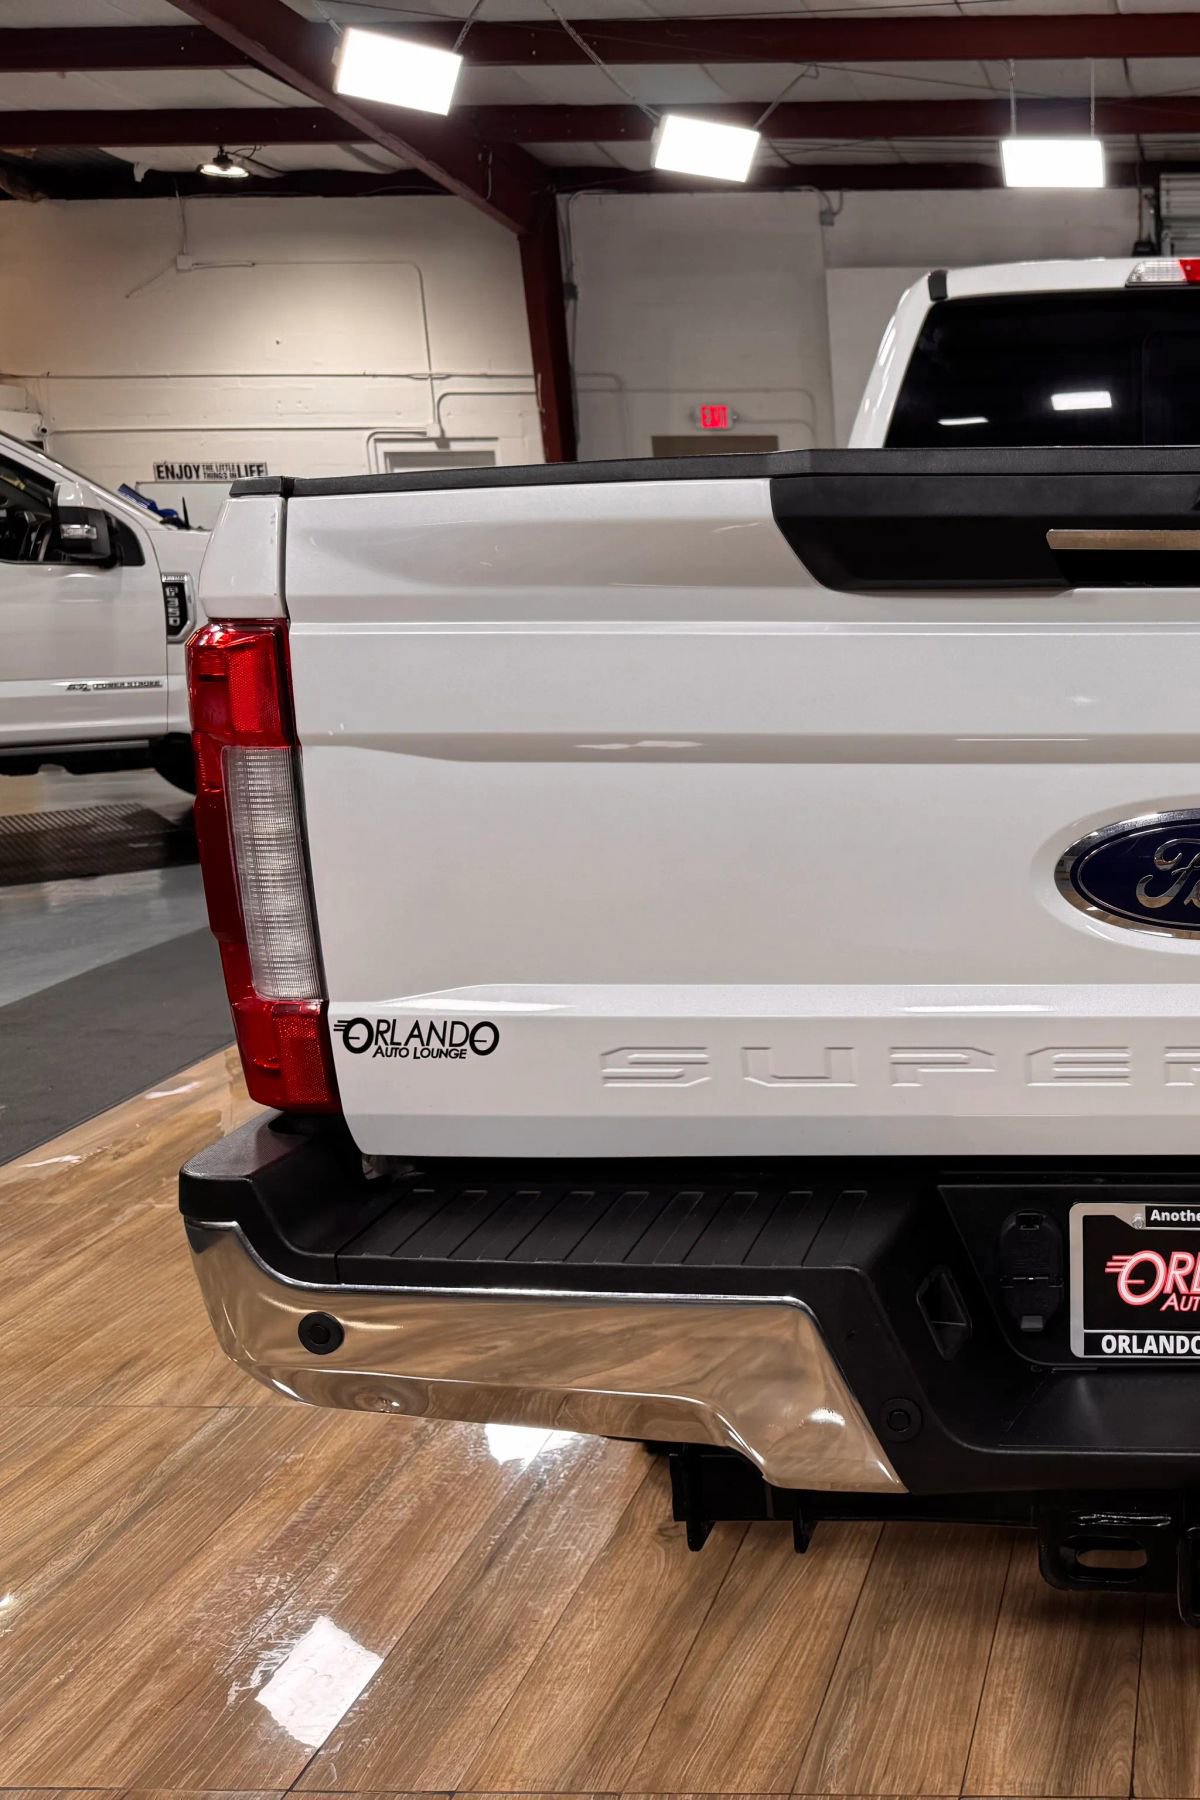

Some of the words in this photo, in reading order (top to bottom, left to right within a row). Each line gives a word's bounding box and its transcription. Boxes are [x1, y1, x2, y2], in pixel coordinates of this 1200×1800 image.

[156, 464, 200, 480] ENJOY
[236, 464, 264, 478] LIFE
[342, 1017, 500, 1056] ORLANDO
[372, 1047, 410, 1058] AUTO
[413, 1047, 468, 1060] LOUNGE
